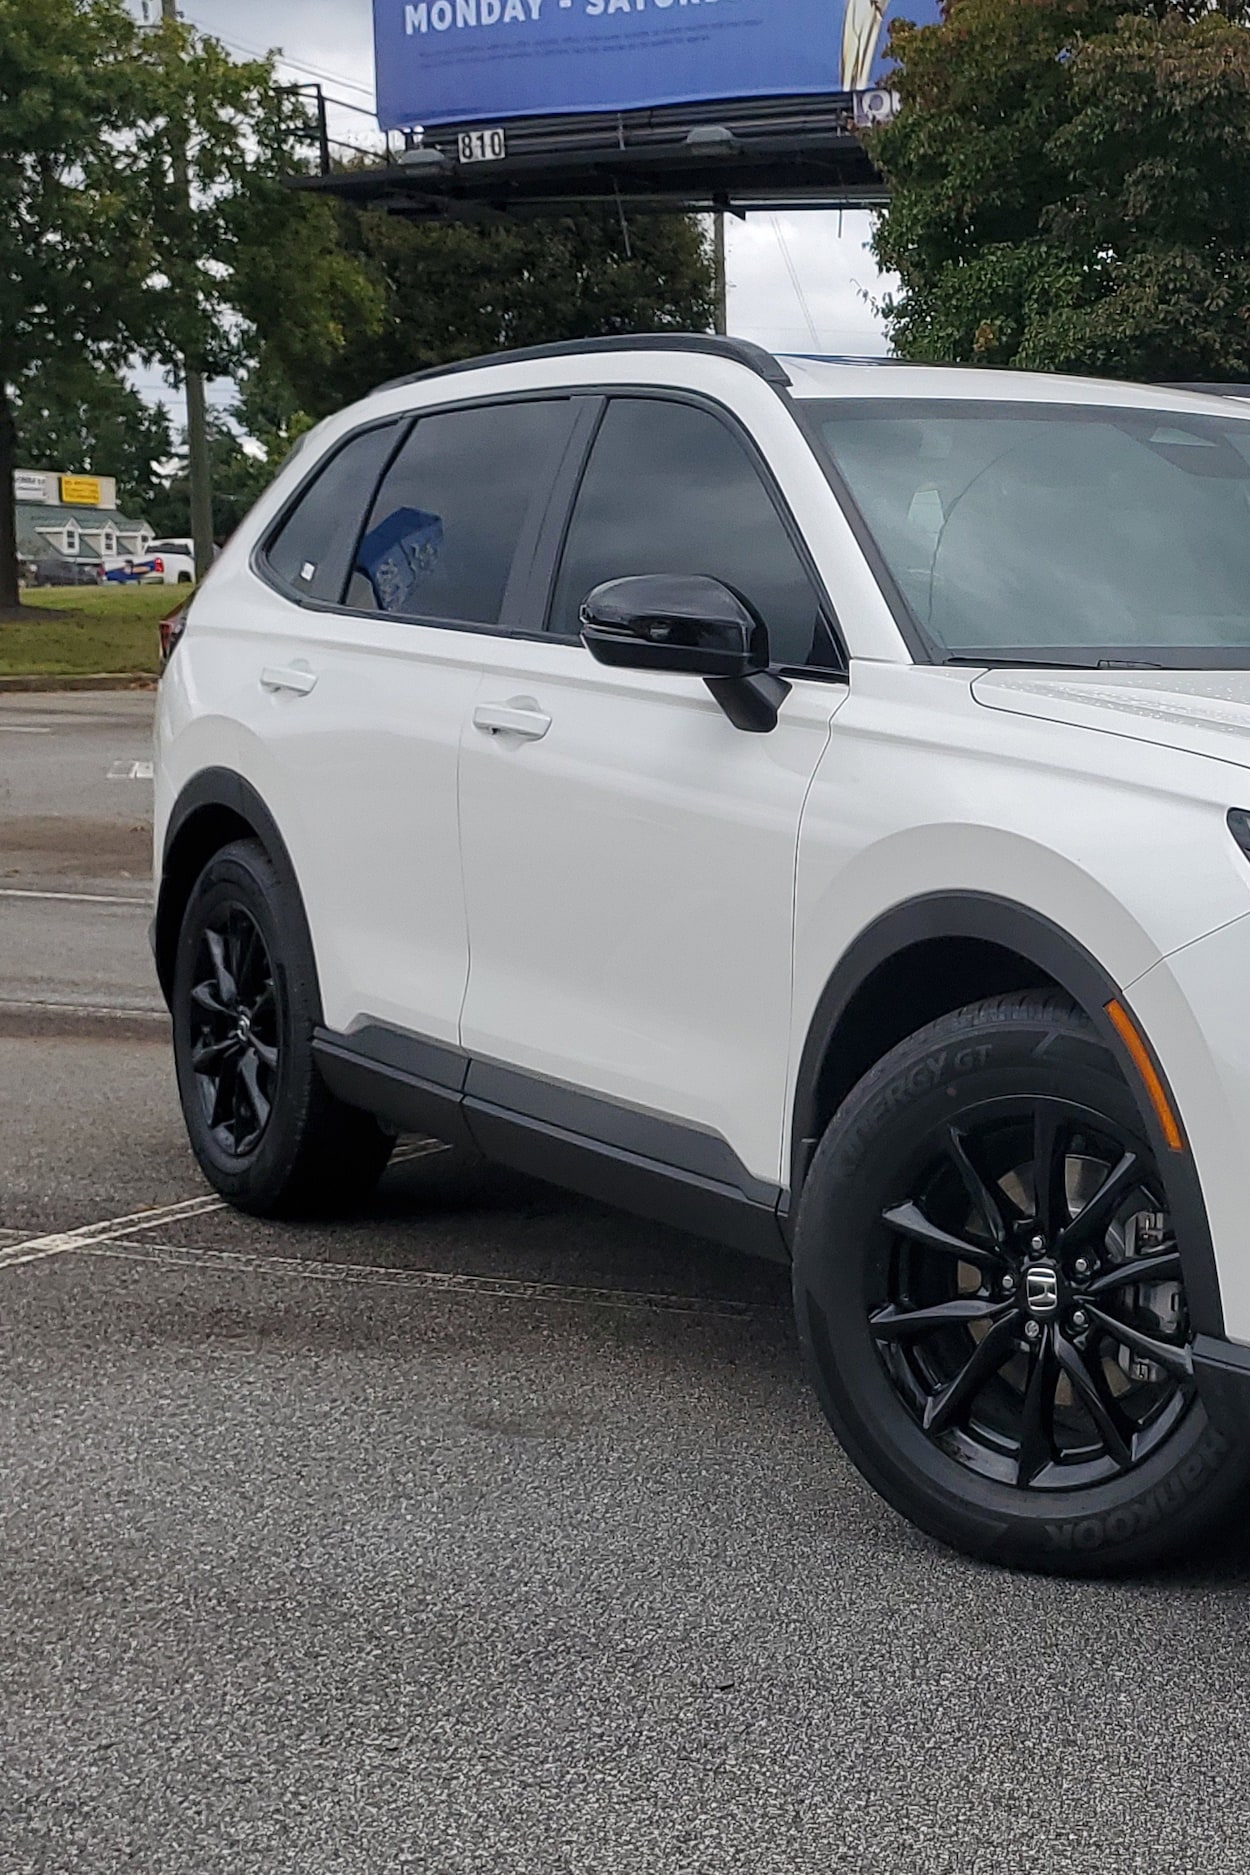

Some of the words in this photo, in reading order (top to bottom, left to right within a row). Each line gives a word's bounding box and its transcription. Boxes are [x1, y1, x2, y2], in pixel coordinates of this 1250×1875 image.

[404, 0, 542, 35] MONDAY
[461, 131, 502, 160] 810
[955, 1044, 992, 1068] GT
